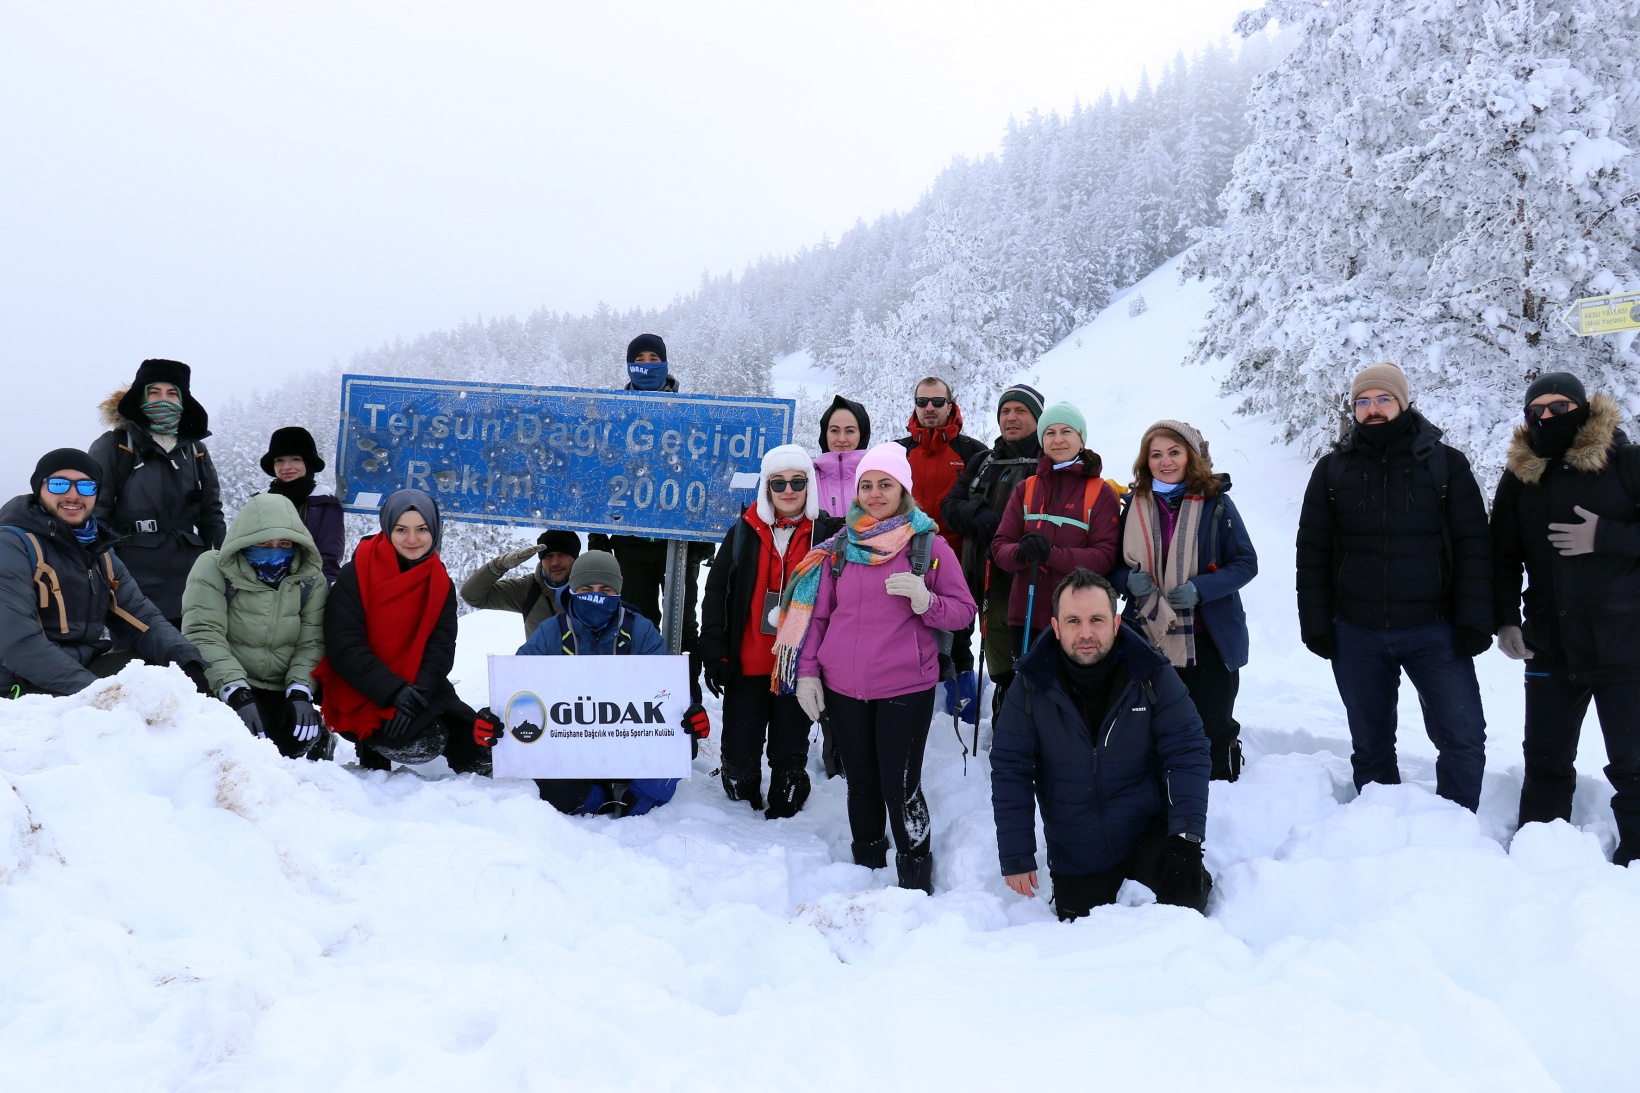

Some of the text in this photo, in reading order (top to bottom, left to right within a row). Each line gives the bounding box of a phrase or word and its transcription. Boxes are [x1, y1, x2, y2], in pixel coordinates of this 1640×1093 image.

[1584, 311, 1600, 319] AKSU
[364, 403, 766, 460] Tersun Dağı Geçidi
[607, 475, 706, 512] 2000
[550, 696, 666, 725] GÜDAK
[550, 728, 675, 739] Gümüşhane Dağcılık ve Doğa Sporları Kulübü
